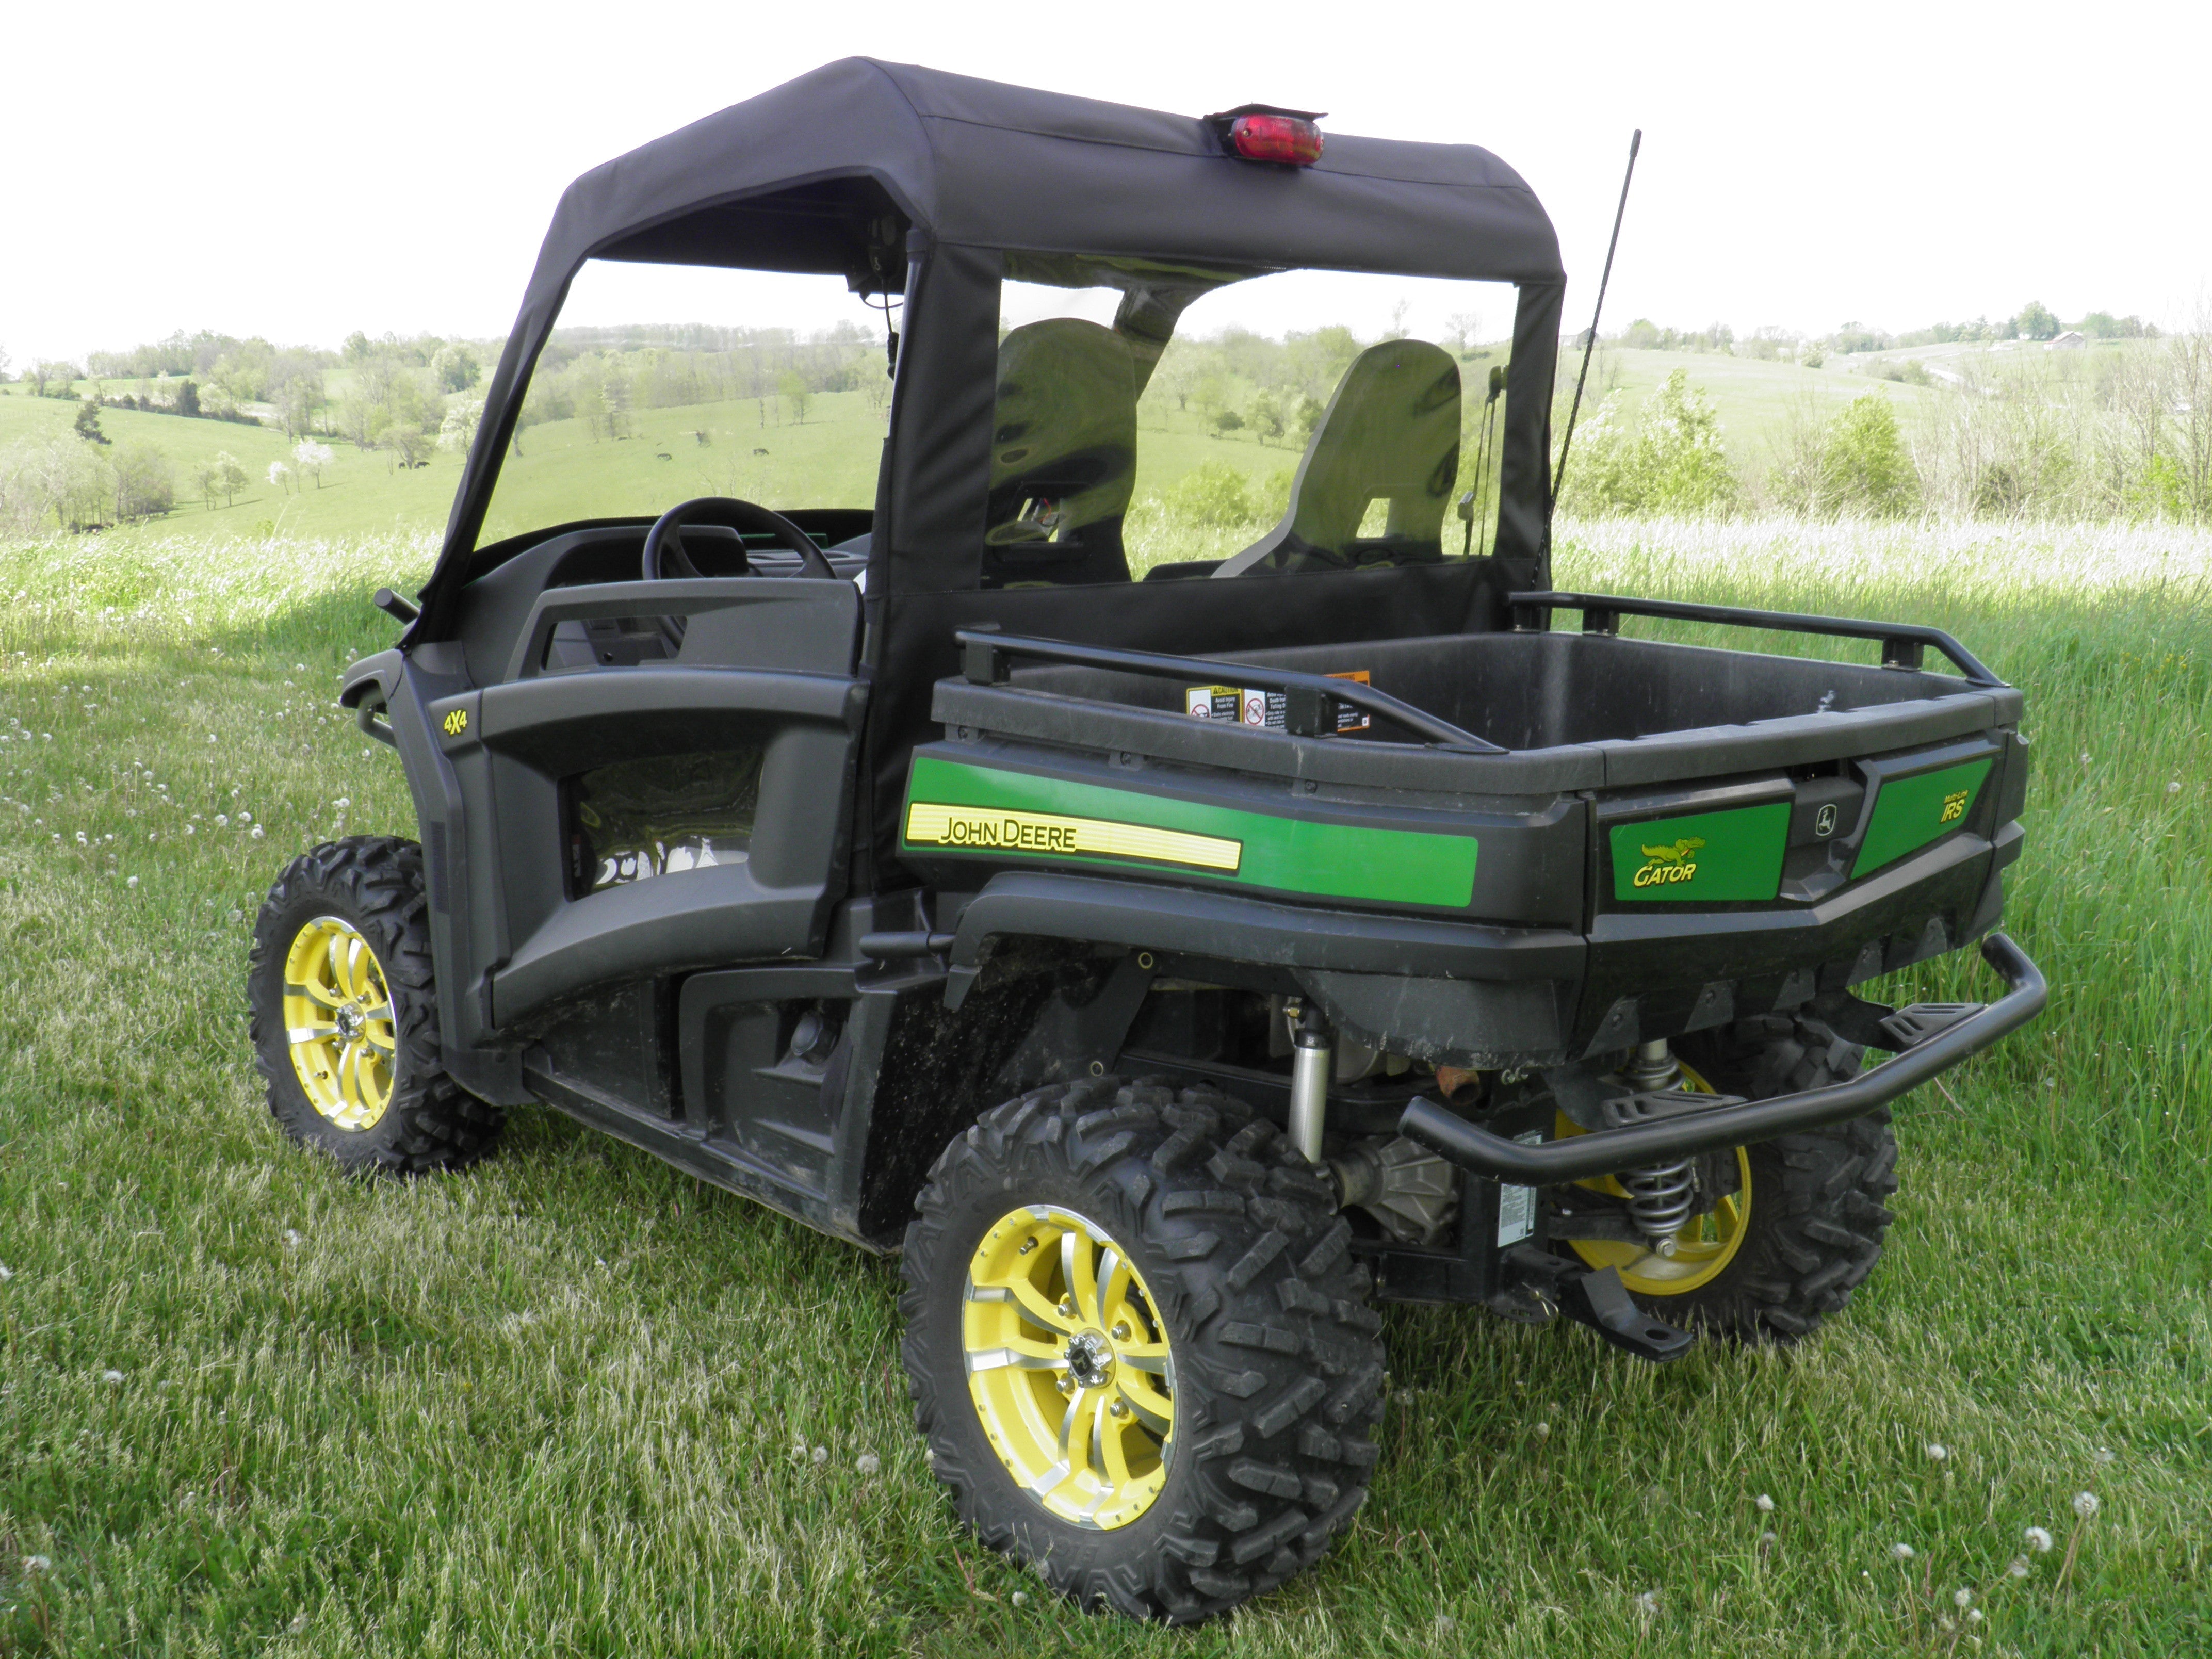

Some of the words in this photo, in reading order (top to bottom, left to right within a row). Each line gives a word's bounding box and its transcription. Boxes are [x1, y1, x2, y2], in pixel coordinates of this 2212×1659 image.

[1941, 799, 1965, 822] IRS
[940, 817, 998, 842] JOHN
[1003, 819, 1077, 849] DEERE
[1634, 863, 1697, 887] GATOR
